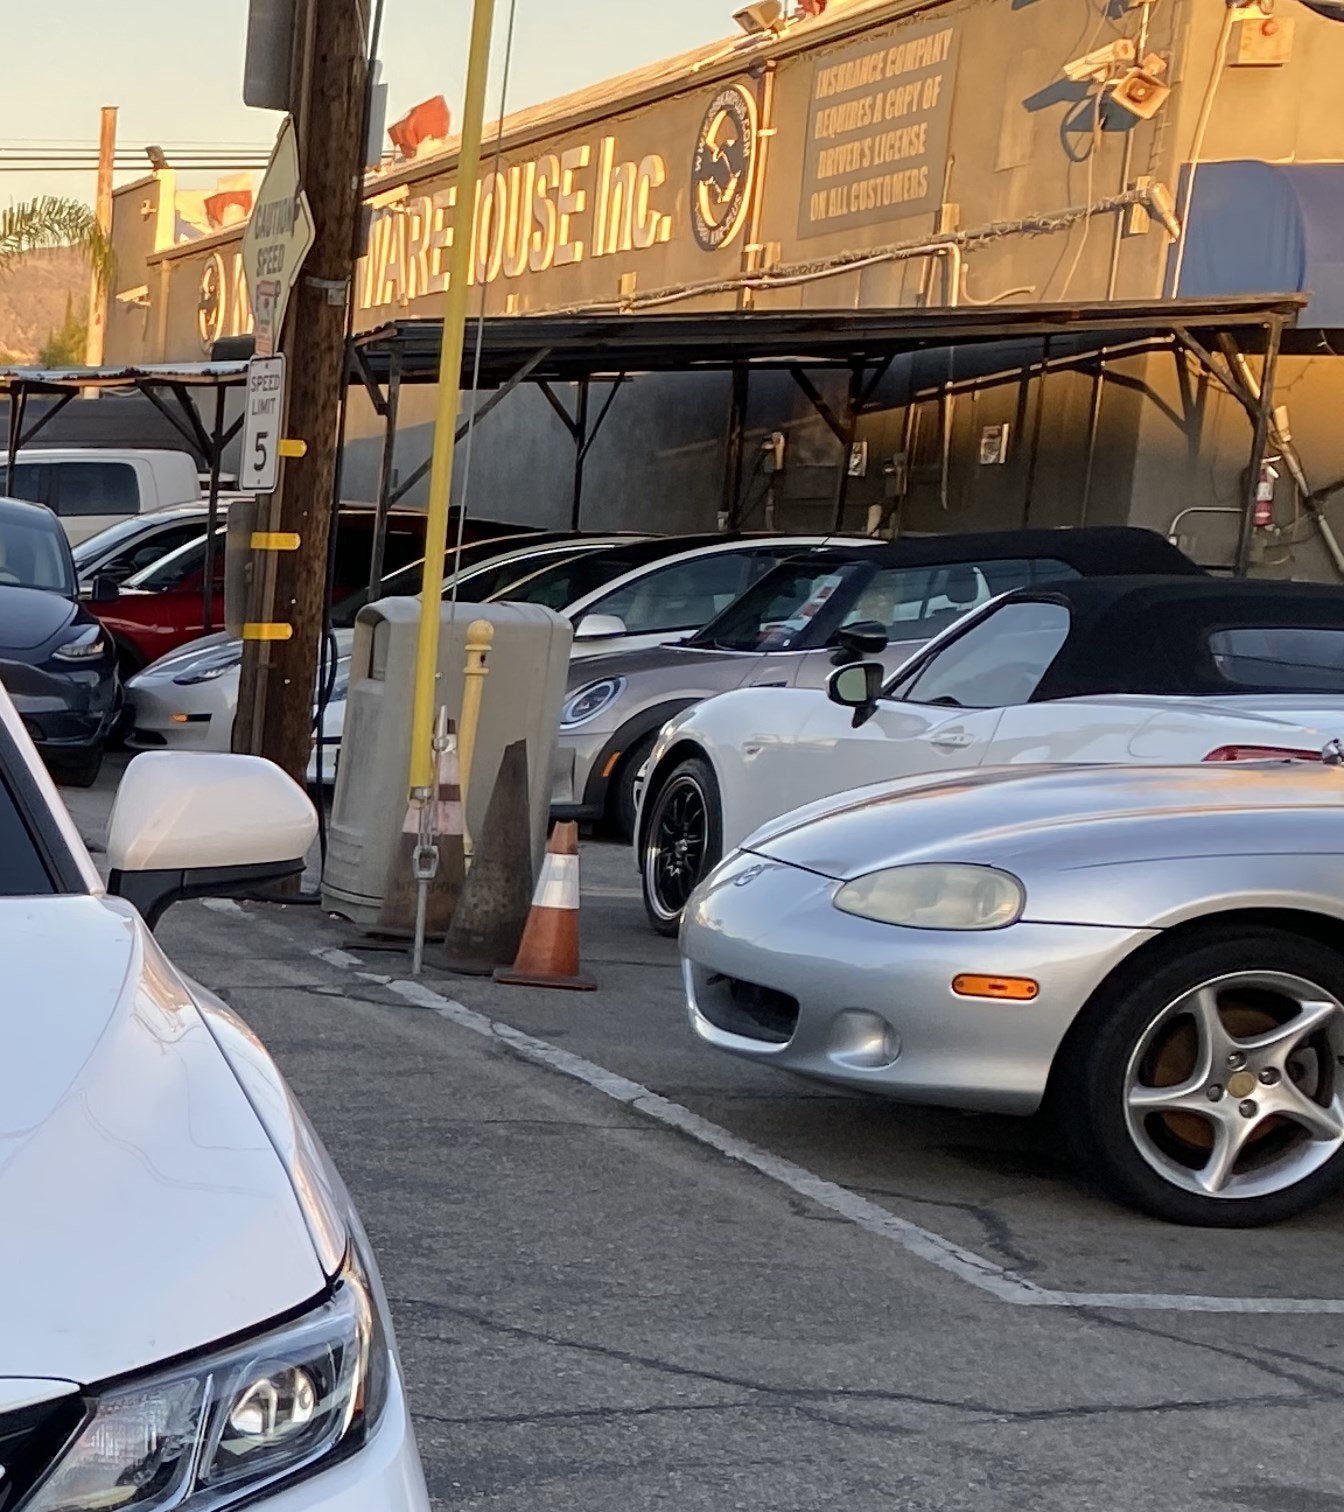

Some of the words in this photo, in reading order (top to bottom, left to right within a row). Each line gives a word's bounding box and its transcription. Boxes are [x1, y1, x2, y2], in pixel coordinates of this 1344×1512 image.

[885, 28, 954, 77] COMPANY
[873, 93, 884, 123] A
[885, 80, 920, 120] COPY
[923, 75, 942, 109] OF
[874, 122, 928, 165] LICENSE
[591, 136, 672, 258] Inc.
[810, 191, 827, 221] ON
[828, 184, 848, 216] ALL
[851, 166, 928, 212] CUSTOMERS
[251, 374, 280, 392] SPEED
[252, 397, 276, 416] LIMIT
[253, 431, 268, 472] 5
